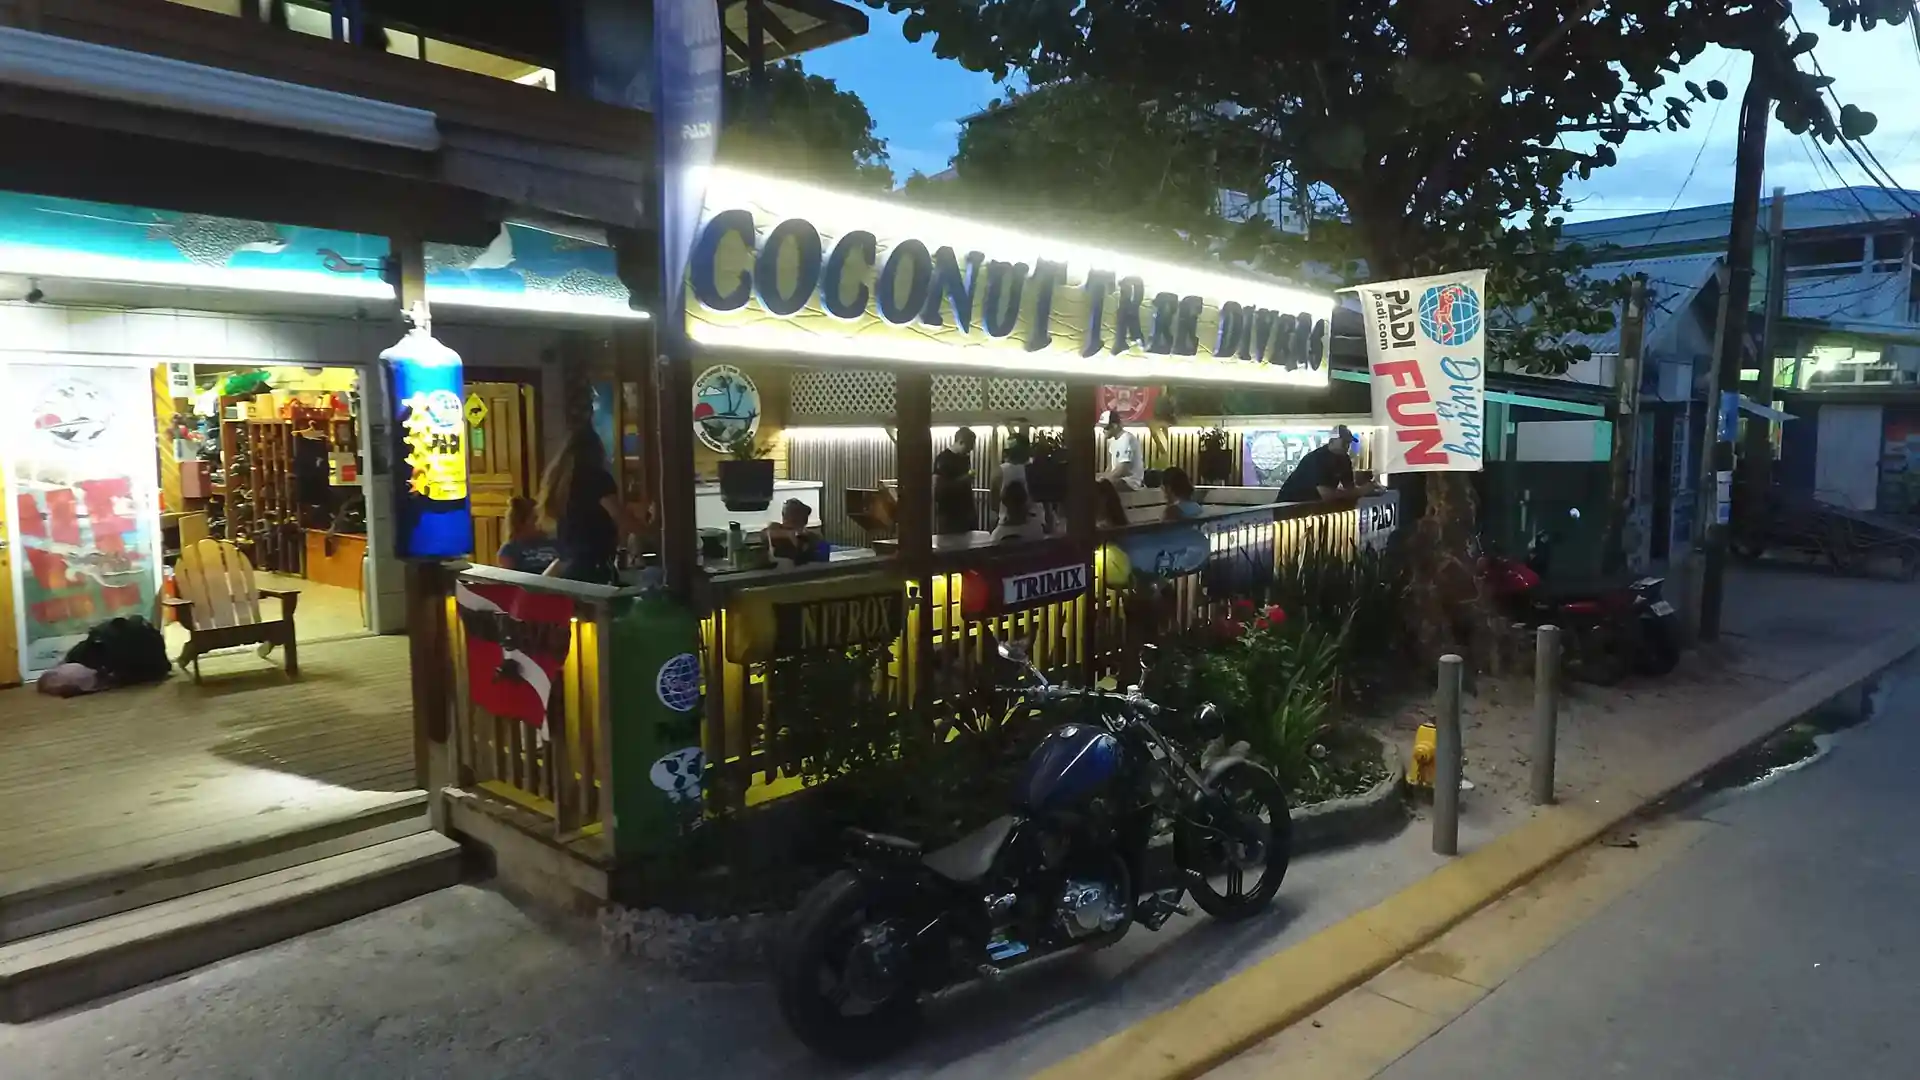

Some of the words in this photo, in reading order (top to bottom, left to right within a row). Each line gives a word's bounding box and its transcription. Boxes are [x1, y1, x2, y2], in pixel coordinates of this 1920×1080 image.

[690, 209, 1068, 352] COCONUT
[1081, 263, 1204, 358] TREE
[1212, 300, 1330, 372] DIVERS
[1386, 289, 1417, 349] PADI
[1372, 293, 1389, 350] padi.com
[1372, 359, 1450, 466] FUN
[1435, 400, 1455, 423] is
[1439, 356, 1482, 459] Diving
[1371, 502, 1396, 531] PADI
[1013, 567, 1082, 601] TRIMIX
[801, 595, 892, 650] NITROX
